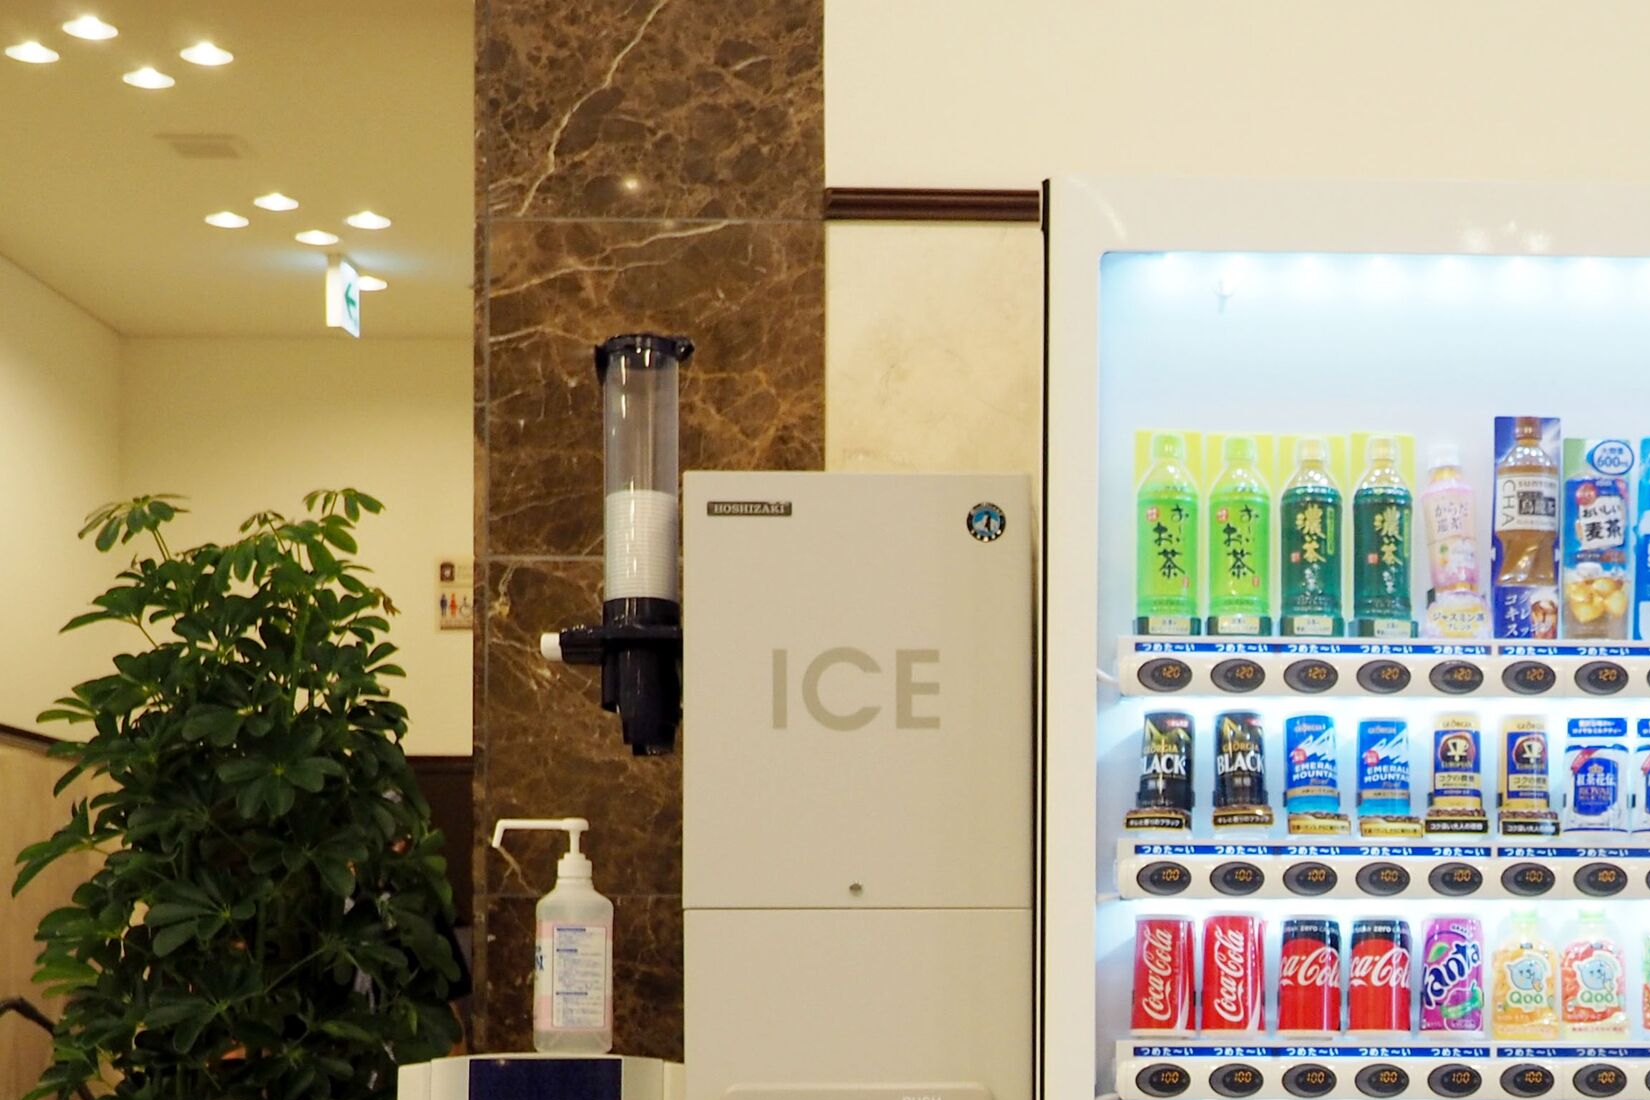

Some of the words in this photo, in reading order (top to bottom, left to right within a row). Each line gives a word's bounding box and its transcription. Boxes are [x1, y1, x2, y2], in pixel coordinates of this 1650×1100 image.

[1501, 479, 1517, 527] CHA
[1584, 518, 1624, 542] 麦茶
[1161, 664, 1181, 679] 120
[1236, 665, 1256, 679] 120
[1380, 666, 1402, 680] 120
[1452, 667, 1473, 682] 120
[771, 647, 942, 732] ICE
[1216, 751, 1265, 776] BLACK
[1162, 867, 1181, 881] 100
[1234, 869, 1253, 881] 100
[1508, 990, 1545, 1006] Qoo
[1580, 990, 1615, 1005] Qoo
[1161, 1069, 1181, 1084] 100
[1234, 1070, 1254, 1084] 100
[1306, 1069, 1326, 1085] 100
[1379, 1070, 1399, 1085] 100
[1453, 1070, 1473, 1085] 100
[1524, 1071, 1544, 1084] 100
